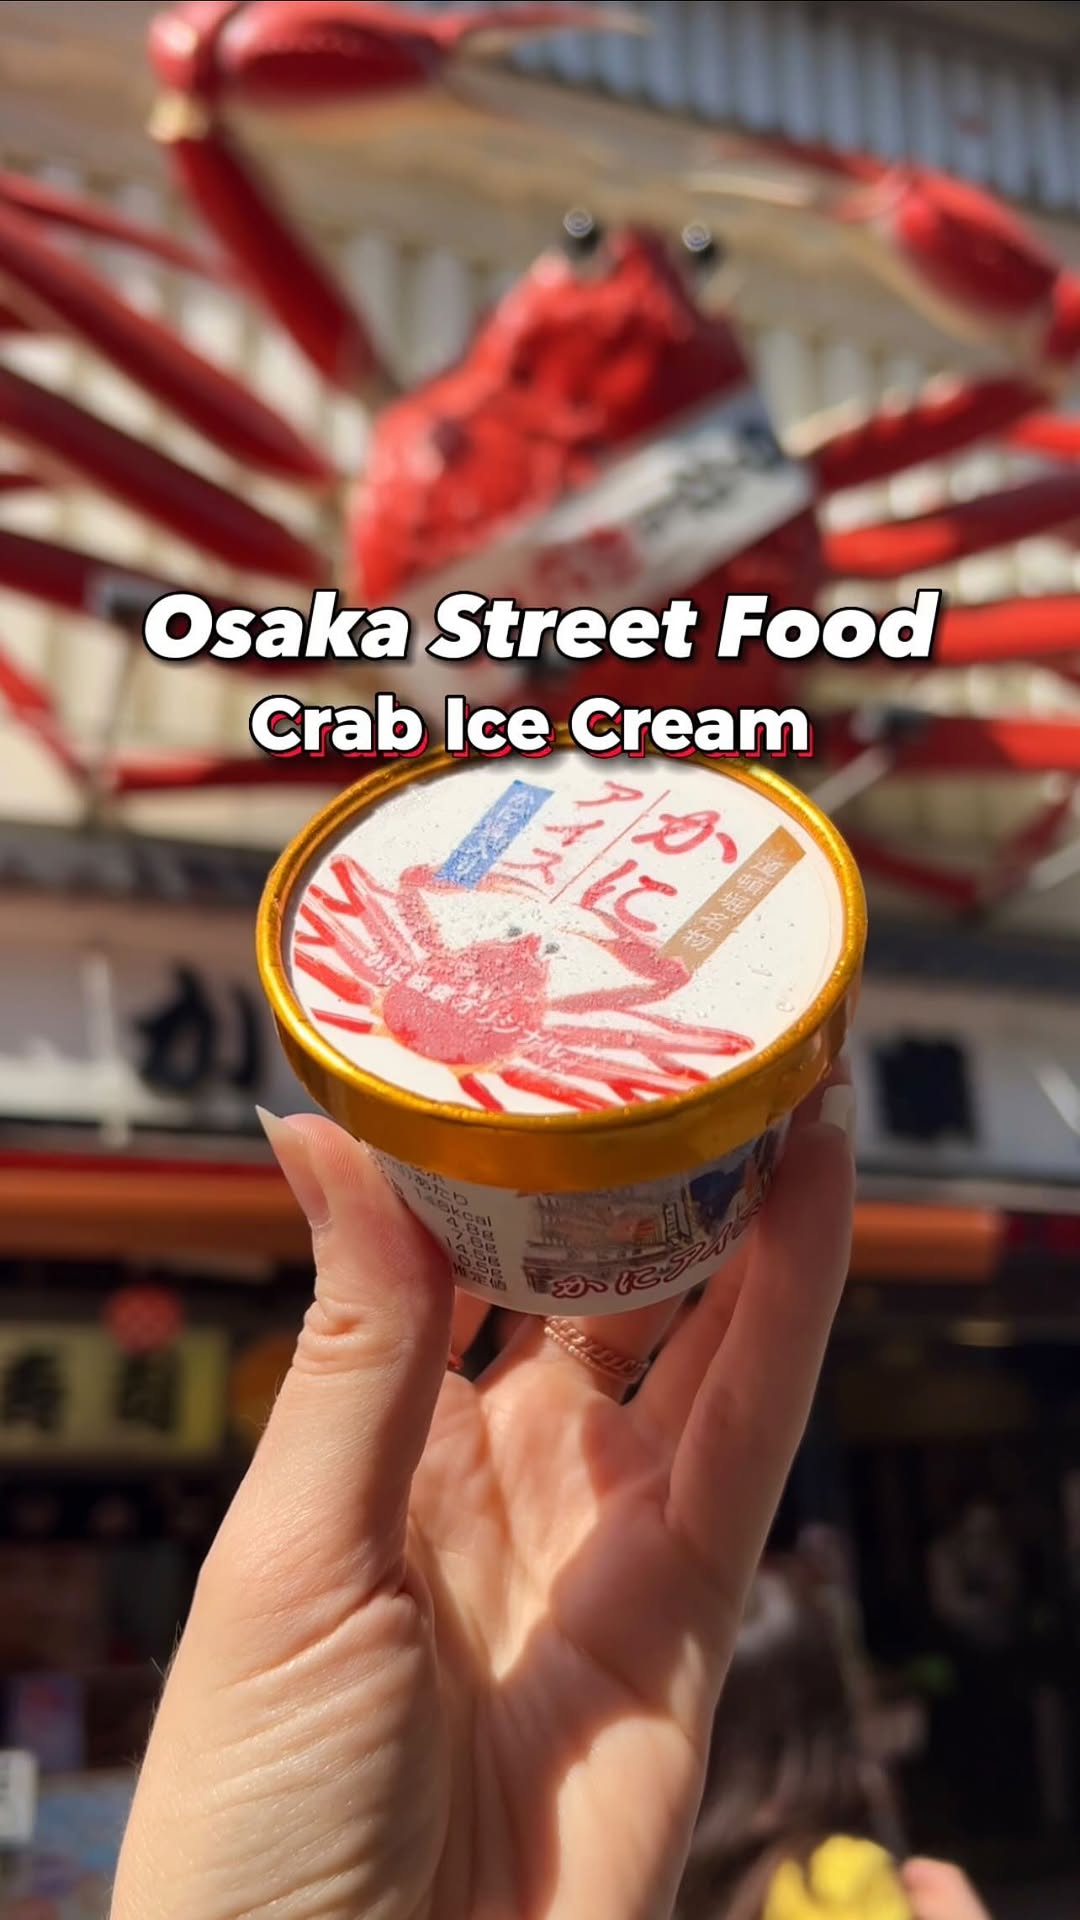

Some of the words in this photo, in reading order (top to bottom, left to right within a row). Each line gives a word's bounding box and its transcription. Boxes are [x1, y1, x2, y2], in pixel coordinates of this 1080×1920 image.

[500, 781, 643, 886] アイス
[581, 810, 738, 933] かに
[683, 851, 785, 951] 道頓堀名物
